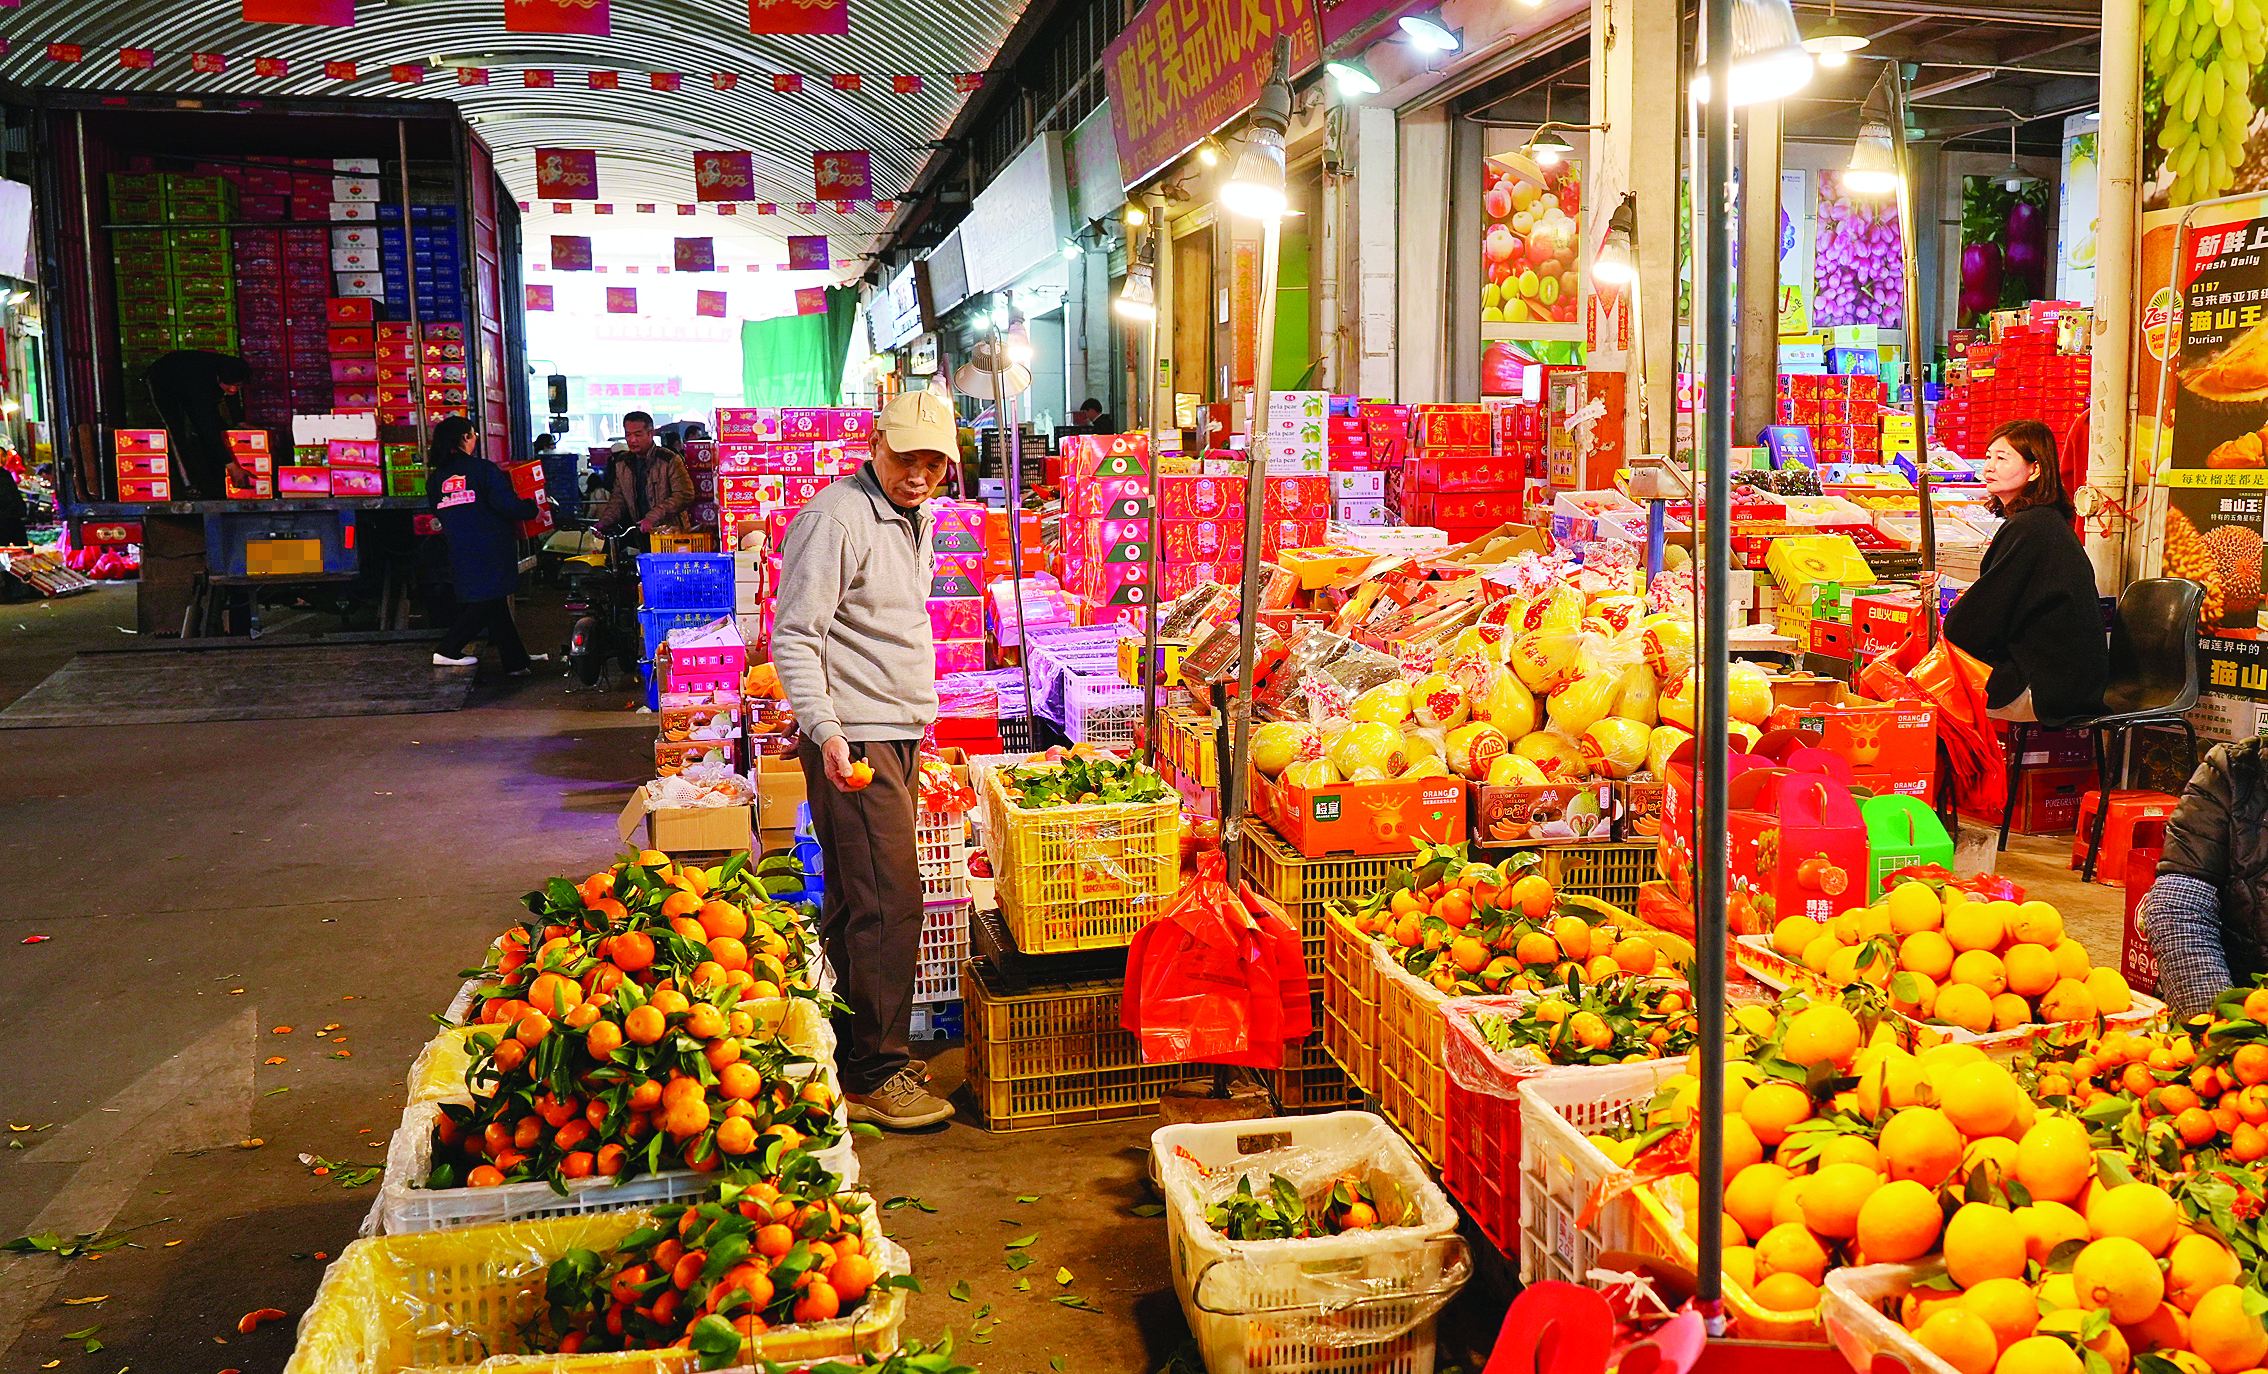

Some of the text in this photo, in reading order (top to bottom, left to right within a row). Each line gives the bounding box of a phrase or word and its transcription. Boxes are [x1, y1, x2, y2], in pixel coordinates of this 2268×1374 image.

[1117, 0, 1304, 142] 鹏发果品批发
[2195, 255, 2260, 272] Fresh Daily
[2144, 307, 2184, 329] Zesri
[2190, 305, 2262, 332] 猫山王
[2188, 335, 2223, 345] Durian
[1446, 471, 1471, 483] 恭喜
[1442, 505, 1468, 517] 恭喜
[2220, 499, 2259, 512] 猫山王
[2211, 514, 2262, 522] 特有的五角星标志
[2198, 638, 2260, 655] 榴莲界中的
[2210, 659, 2268, 691] 猫山
[1423, 787, 1459, 797] ORANGE
[1541, 790, 1559, 801] AA
[2046, 797, 2083, 807] POMEGRANAT
[1316, 802, 1340, 815] 橙皇
[1806, 900, 1828, 910] 精选
